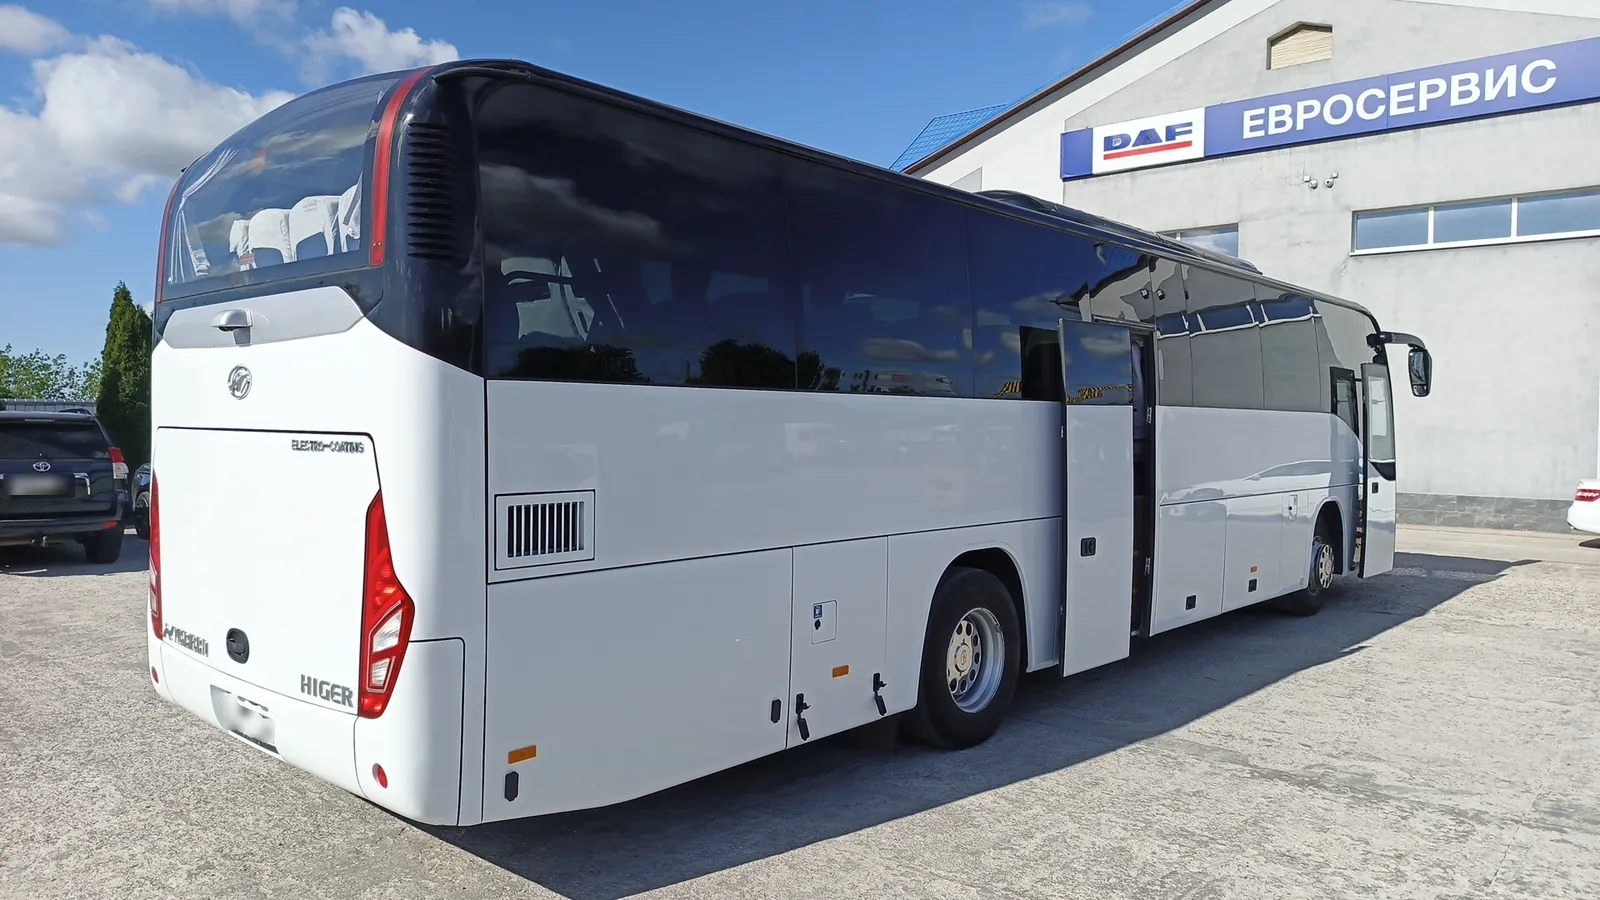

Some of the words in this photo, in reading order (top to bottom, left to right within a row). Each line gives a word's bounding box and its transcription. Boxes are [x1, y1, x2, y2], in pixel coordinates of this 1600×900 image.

[1242, 58, 1557, 139] ЕВРОСЕРВИС
[1103, 121, 1193, 152] DAF
[300, 673, 354, 708] HIGER
